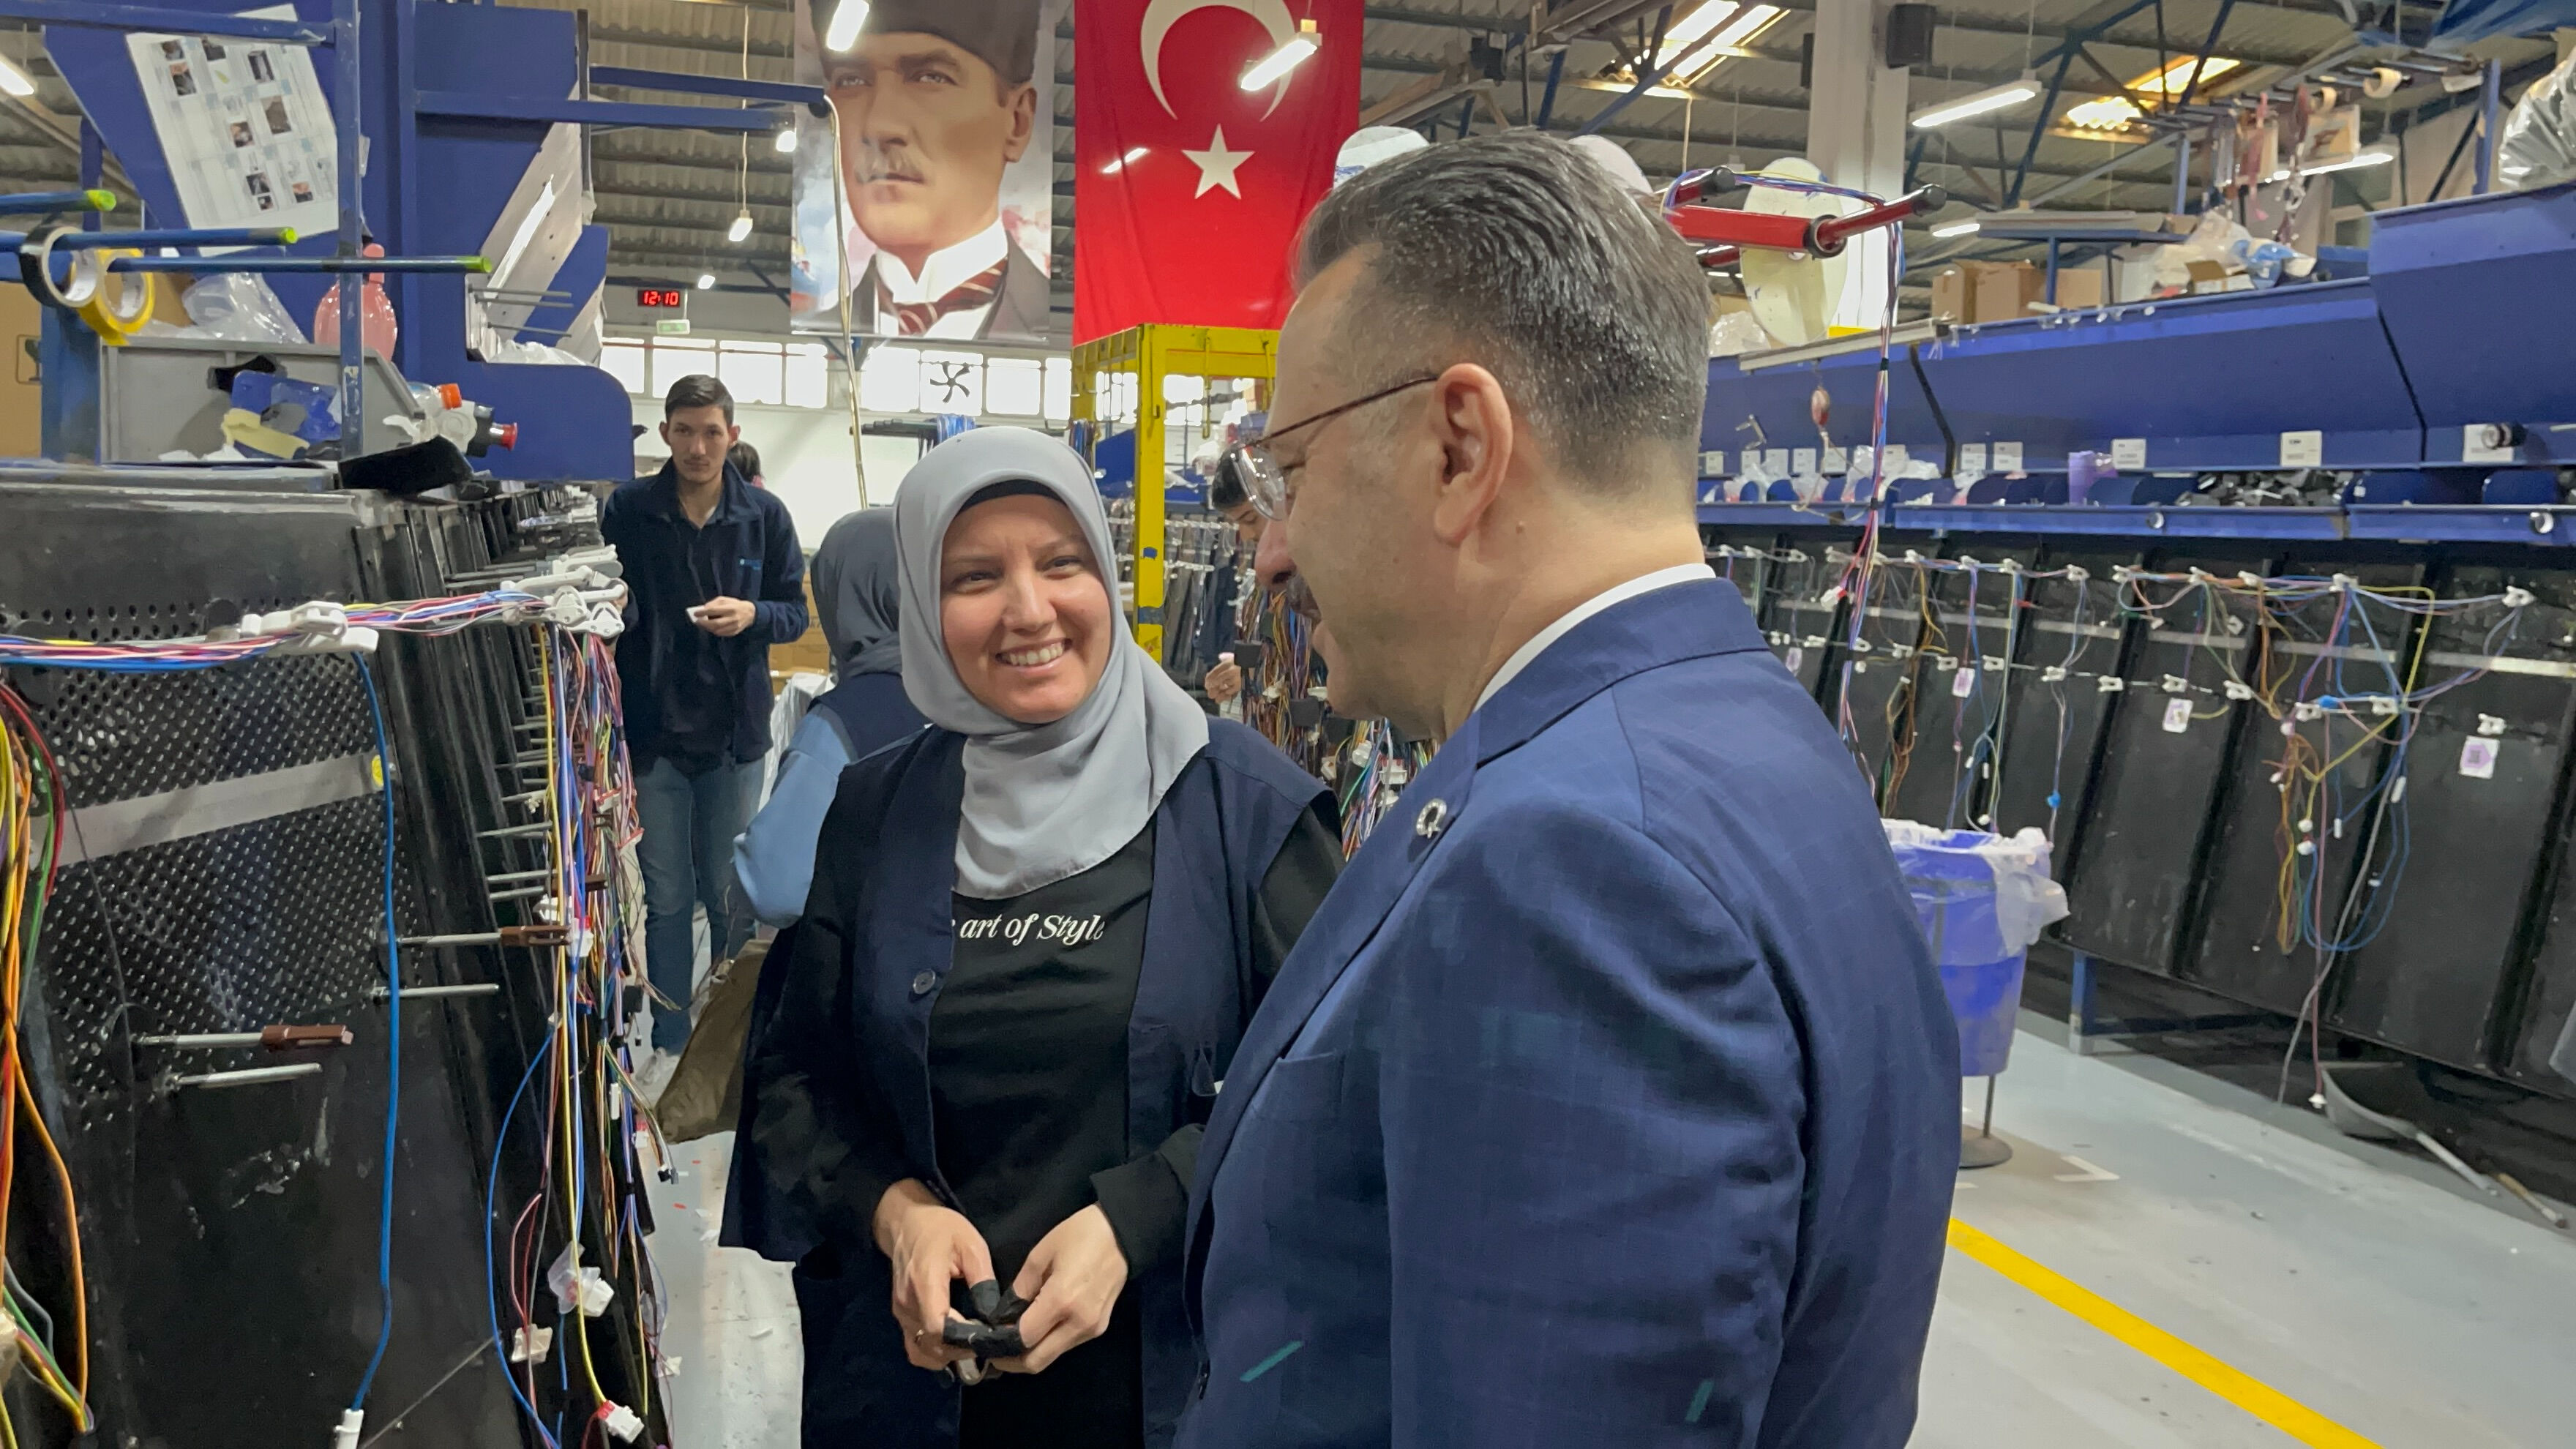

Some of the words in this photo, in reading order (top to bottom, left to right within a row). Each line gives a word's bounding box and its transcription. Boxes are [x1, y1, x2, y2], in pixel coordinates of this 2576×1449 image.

[643, 291, 680, 306] 12:10
[959, 913, 1003, 939] art
[1004, 913, 1040, 946] of
